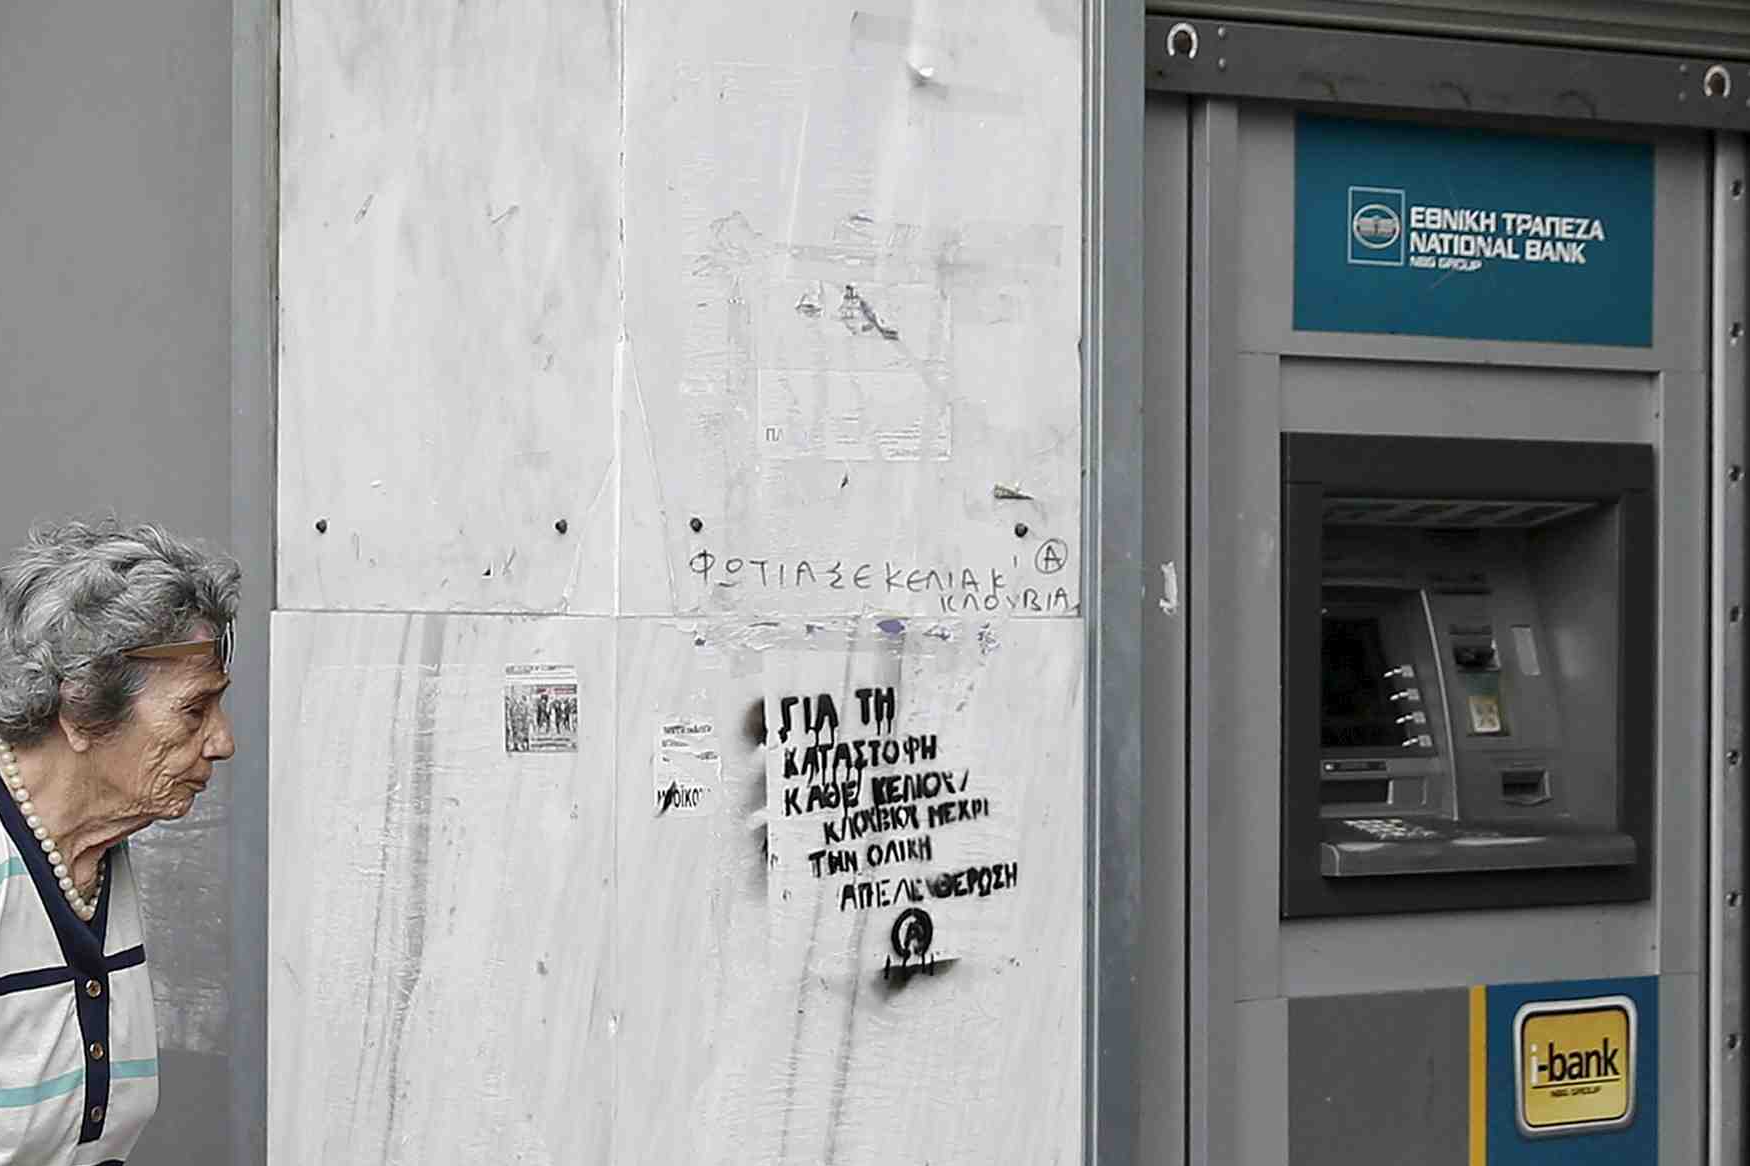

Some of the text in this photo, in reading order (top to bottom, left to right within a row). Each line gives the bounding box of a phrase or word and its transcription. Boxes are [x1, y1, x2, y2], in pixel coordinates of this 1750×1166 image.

[1410, 206, 1605, 242] ΕΘΝΙΚΗ ΤΡΑΠΕΖΑ
[1410, 231, 1586, 265] NATIONAL BANK
[1438, 257, 1483, 271] GROUP
[778, 687, 895, 743] ΓΙΑ ΤΗ
[928, 798, 989, 828] ΜΕΧΡΙ
[866, 834, 932, 867] ΟΛΙΚΗ
[1530, 1037, 1620, 1085] i-bank
